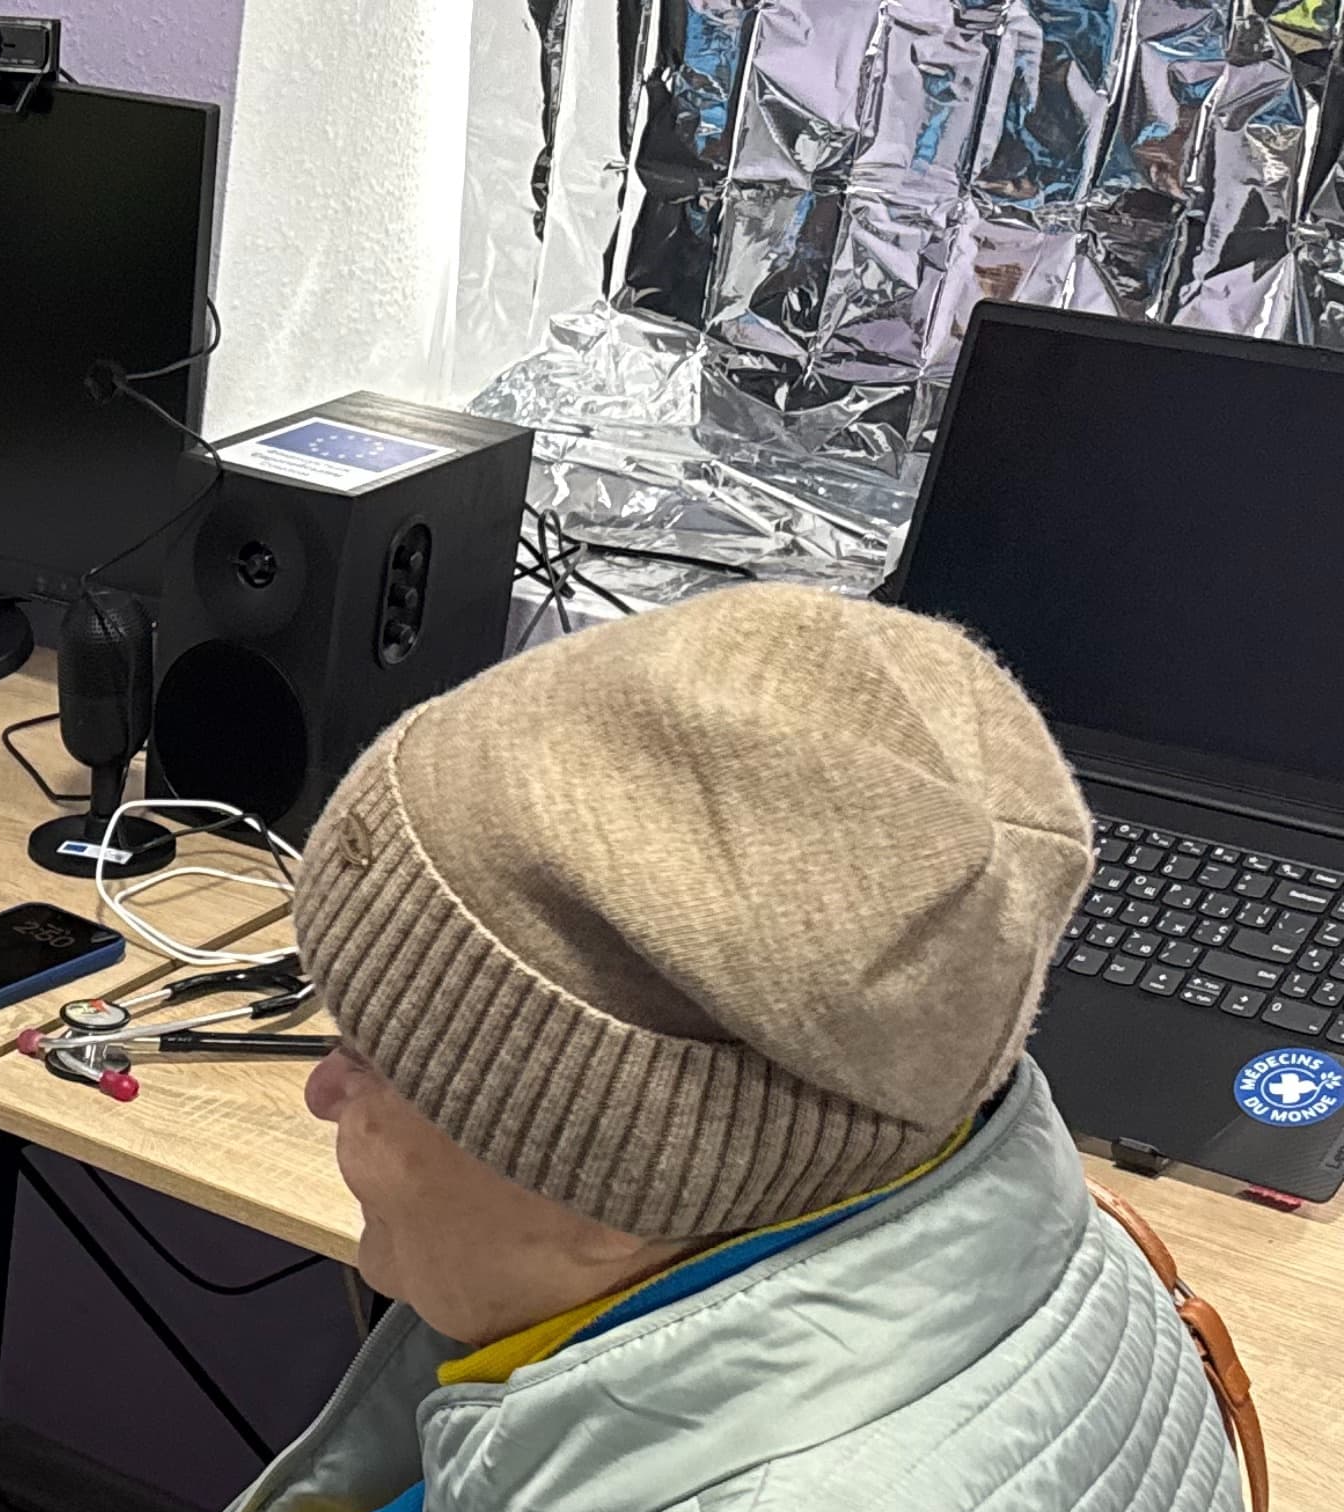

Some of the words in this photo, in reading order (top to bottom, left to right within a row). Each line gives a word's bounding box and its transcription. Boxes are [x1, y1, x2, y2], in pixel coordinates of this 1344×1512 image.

[1240, 1053, 1324, 1090] MÉDECINS
[1243, 1096, 1270, 1115] DU
[1270, 1095, 1337, 1122] MONDE
